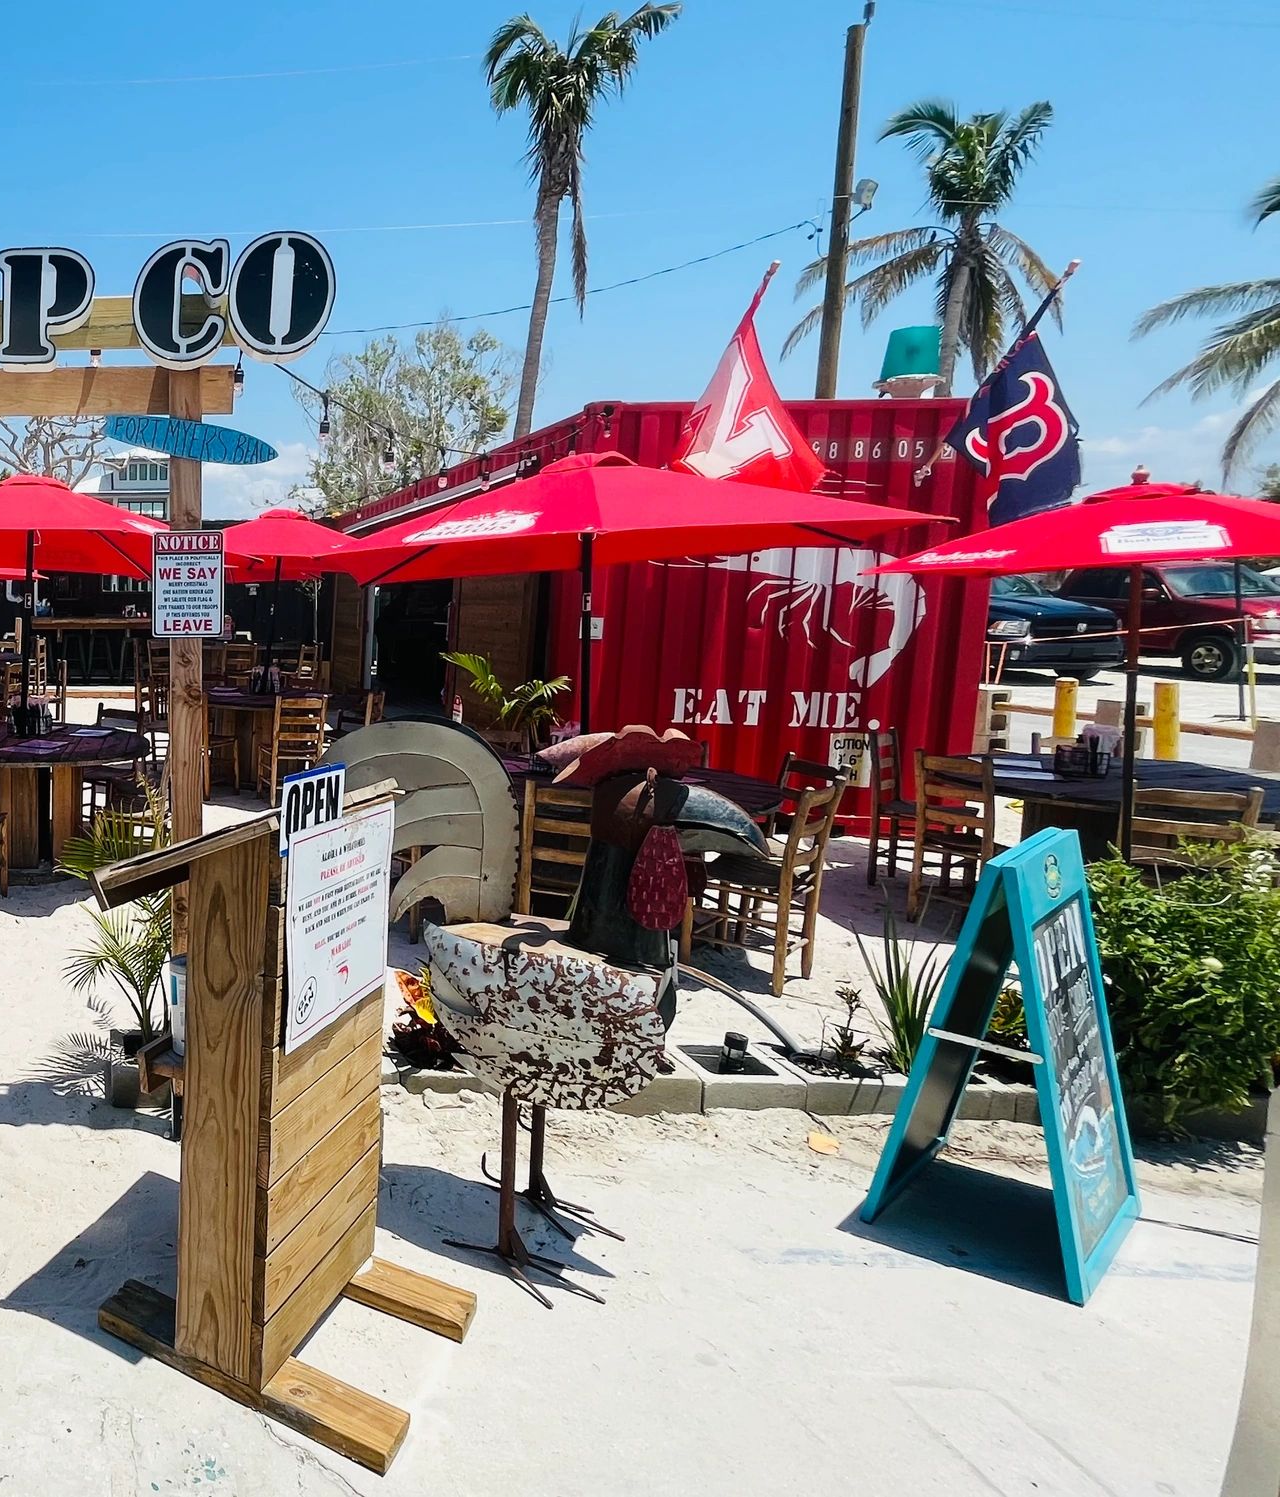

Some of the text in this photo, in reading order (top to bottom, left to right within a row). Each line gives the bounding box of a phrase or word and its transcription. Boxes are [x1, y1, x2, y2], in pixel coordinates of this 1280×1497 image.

[136, 229, 338, 364] CO
[114, 416, 276, 464] FORT MYERS BEACH
[158, 536, 219, 551] NOTICE
[159, 567, 217, 579] WE SAY
[163, 620, 213, 631] LEAVE
[671, 688, 880, 730] EAT ME.
[286, 774, 341, 835] OPEN
